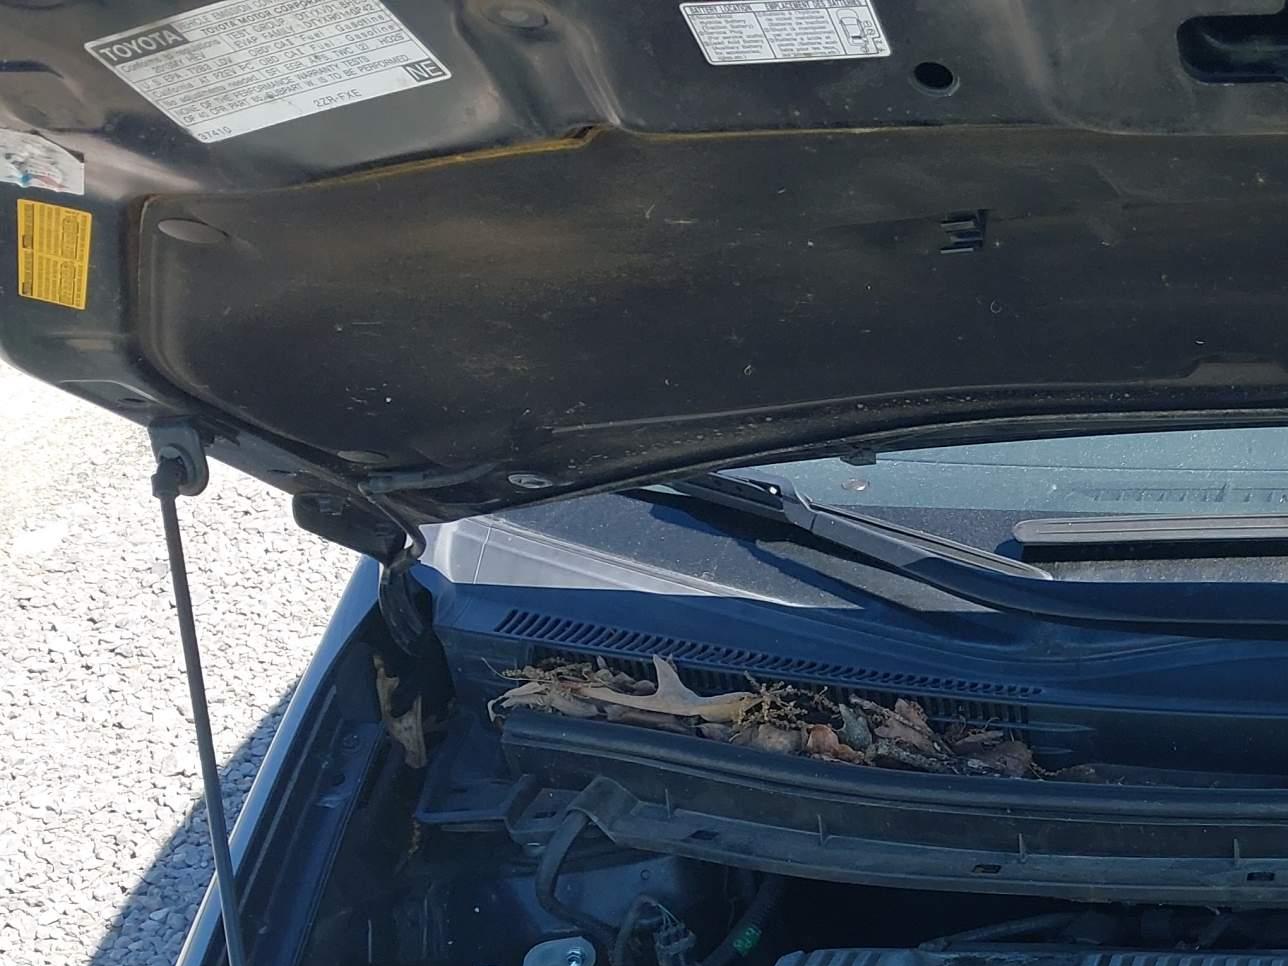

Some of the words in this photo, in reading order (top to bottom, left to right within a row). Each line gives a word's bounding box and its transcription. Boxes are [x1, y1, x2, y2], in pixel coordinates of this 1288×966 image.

[199, 19, 238, 35] TOYOTA
[235, 8, 274, 24] MOTOR
[343, 22, 395, 42] Gasoline
[97, 27, 183, 62] TOYOTA
[403, 59, 444, 81] NE
